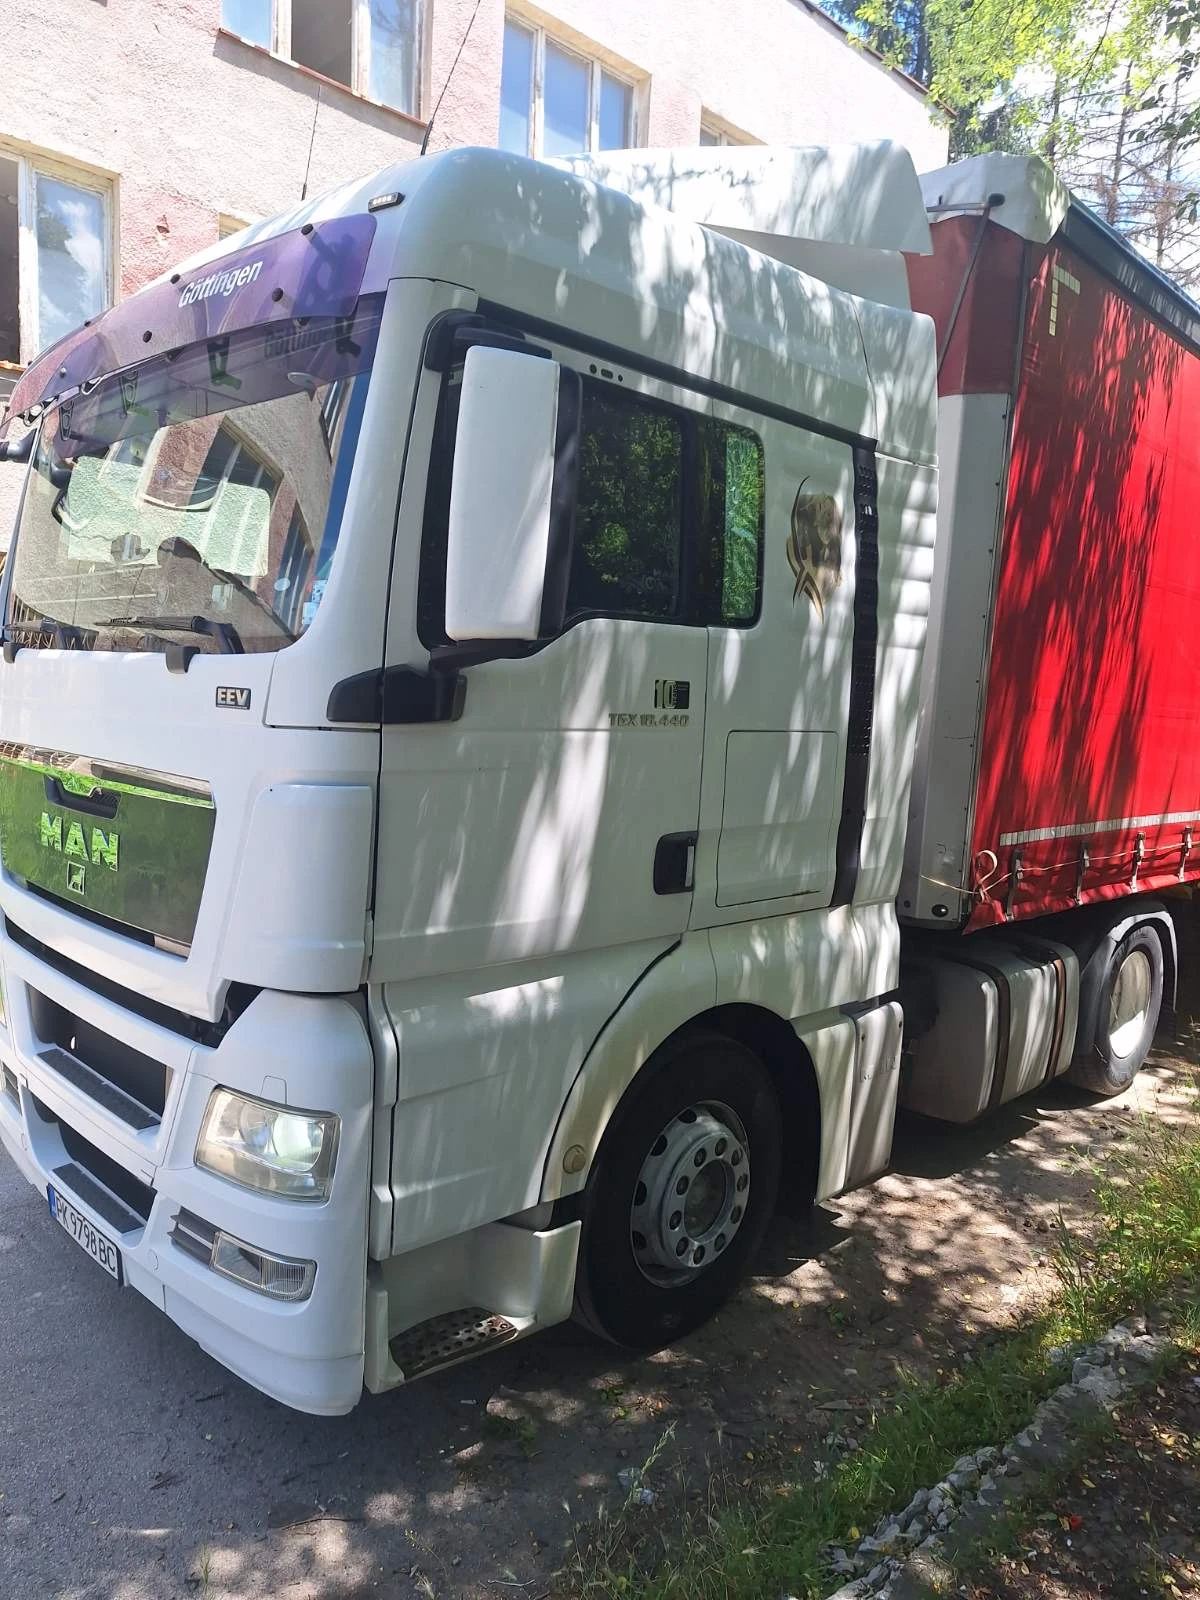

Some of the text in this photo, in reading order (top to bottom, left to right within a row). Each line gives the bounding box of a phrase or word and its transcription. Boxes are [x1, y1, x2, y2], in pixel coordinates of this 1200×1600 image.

[178, 261, 263, 308] Göttingen
[217, 687, 249, 706] EEV
[40, 811, 120, 872] MAN
[70, 1212, 97, 1256] 9798
[99, 1239, 116, 1273] BC
